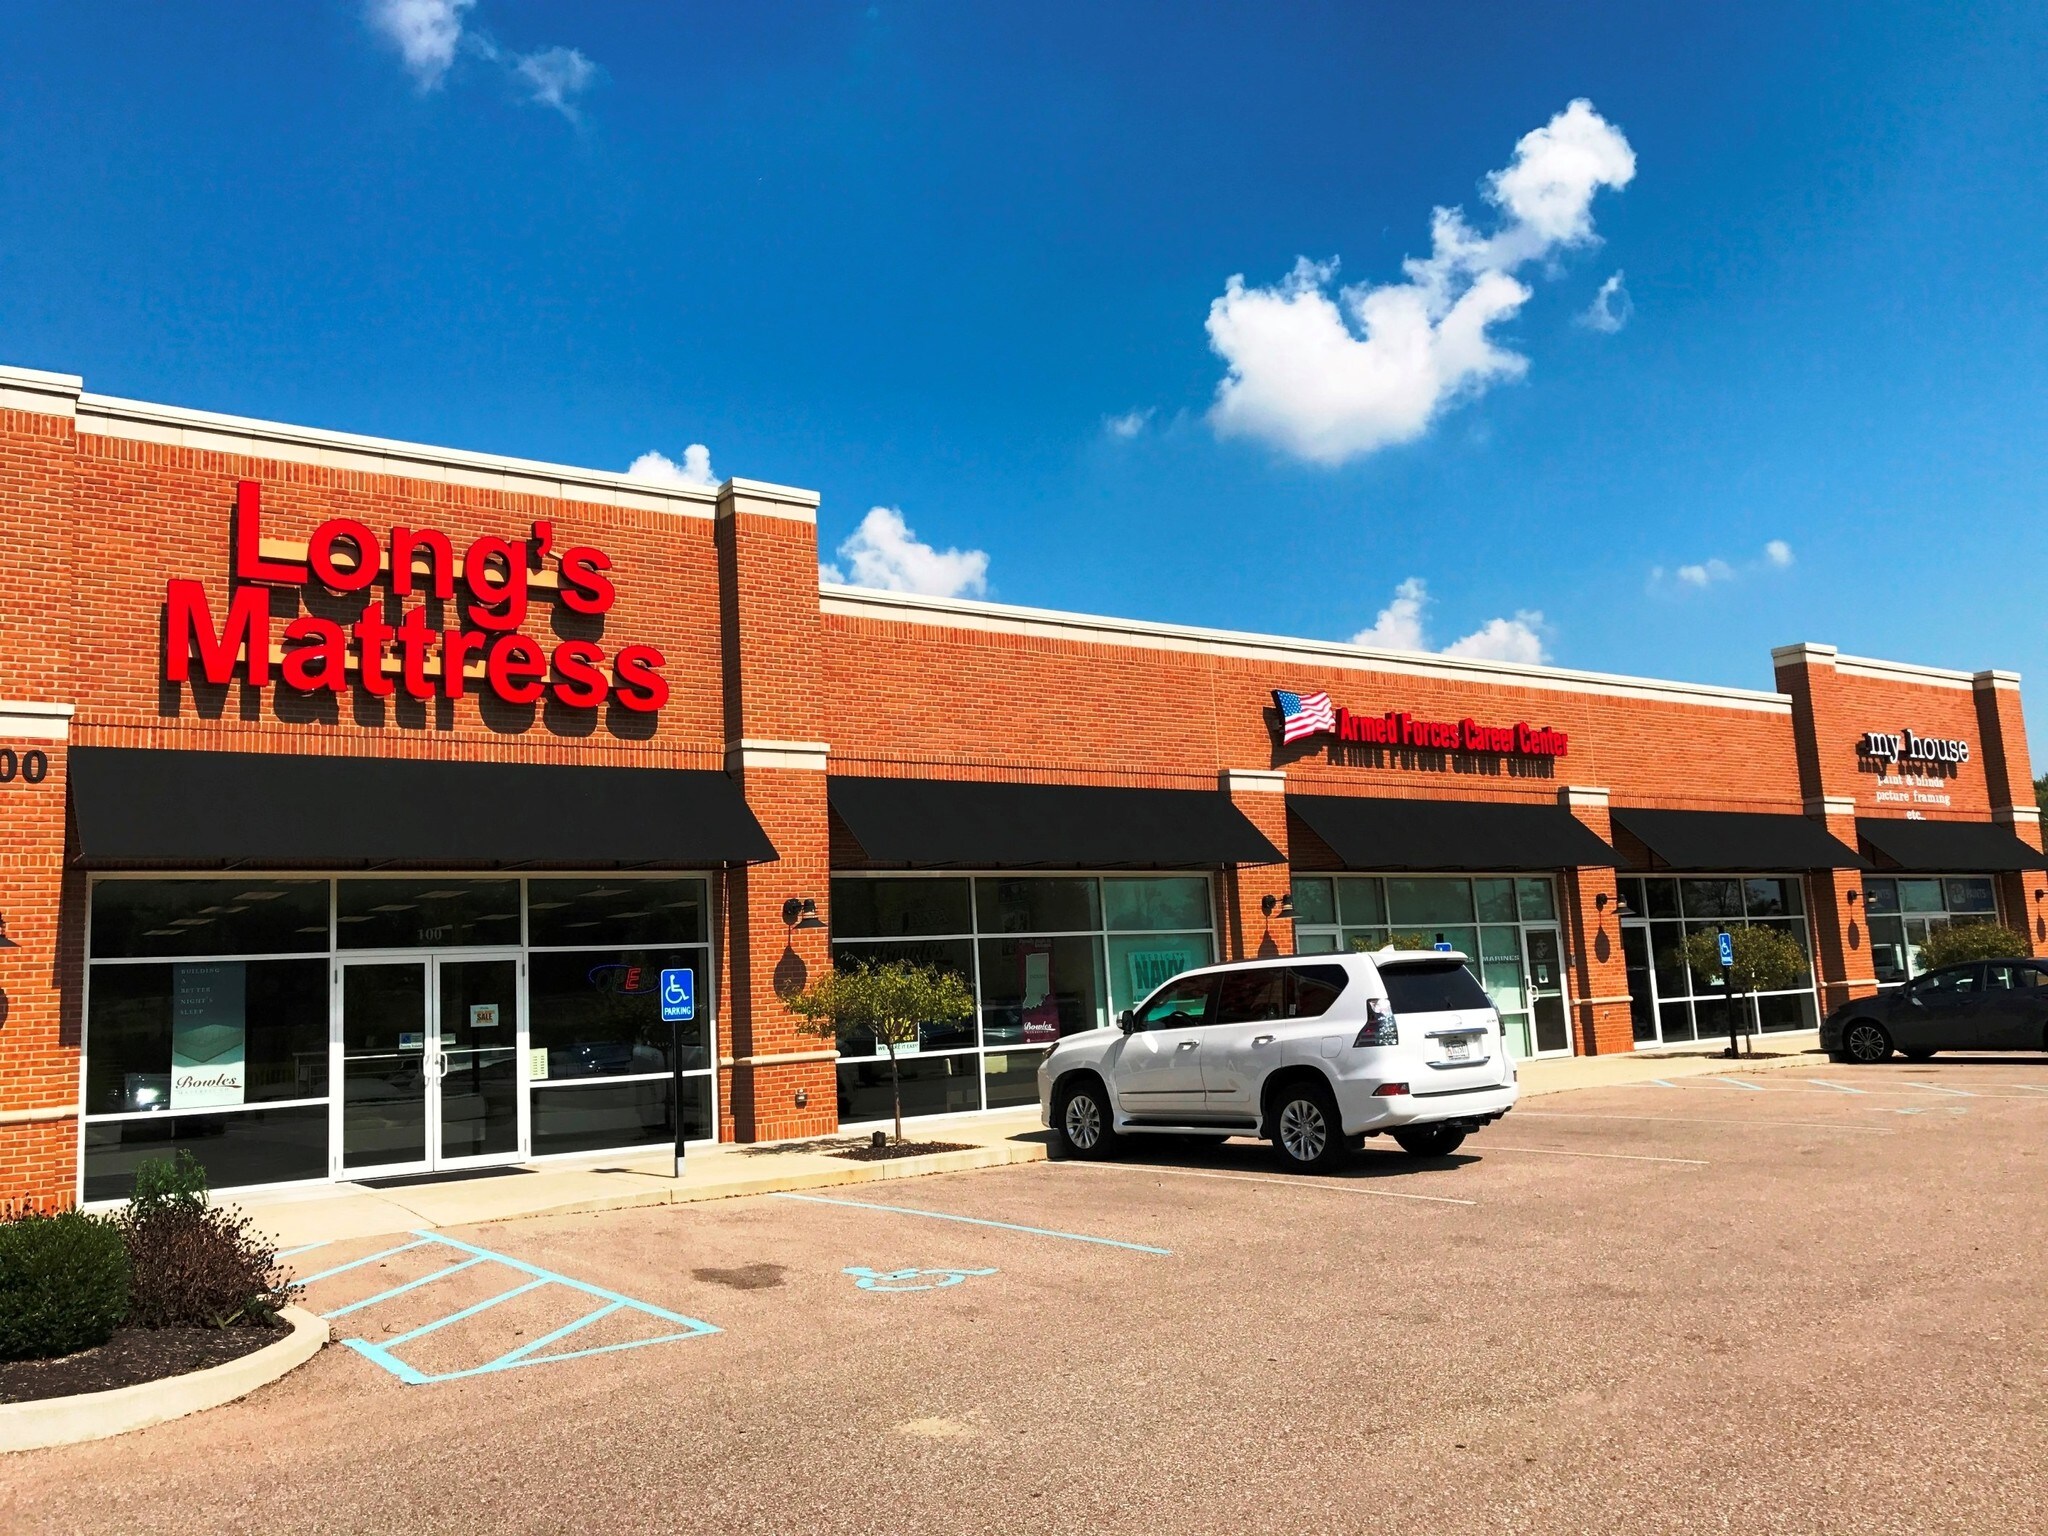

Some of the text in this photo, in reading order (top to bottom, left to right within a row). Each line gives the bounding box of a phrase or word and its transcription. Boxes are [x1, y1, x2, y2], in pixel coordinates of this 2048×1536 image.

[236, 480, 615, 631] Long's
[166, 579, 670, 711] Mattress
[1338, 707, 1568, 756] Armed Forces Career Center
[1868, 728, 1969, 763] my house
[1877, 775, 1945, 788] paint & blinds
[1876, 790, 1951, 806] picture framing
[1482, 954, 1520, 962] MARINES
[1135, 959, 1185, 989] NAVY
[476, 1012, 493, 1021] SALE
[664, 1006, 692, 1016] PARKING
[175, 1073, 241, 1089] Bowles
